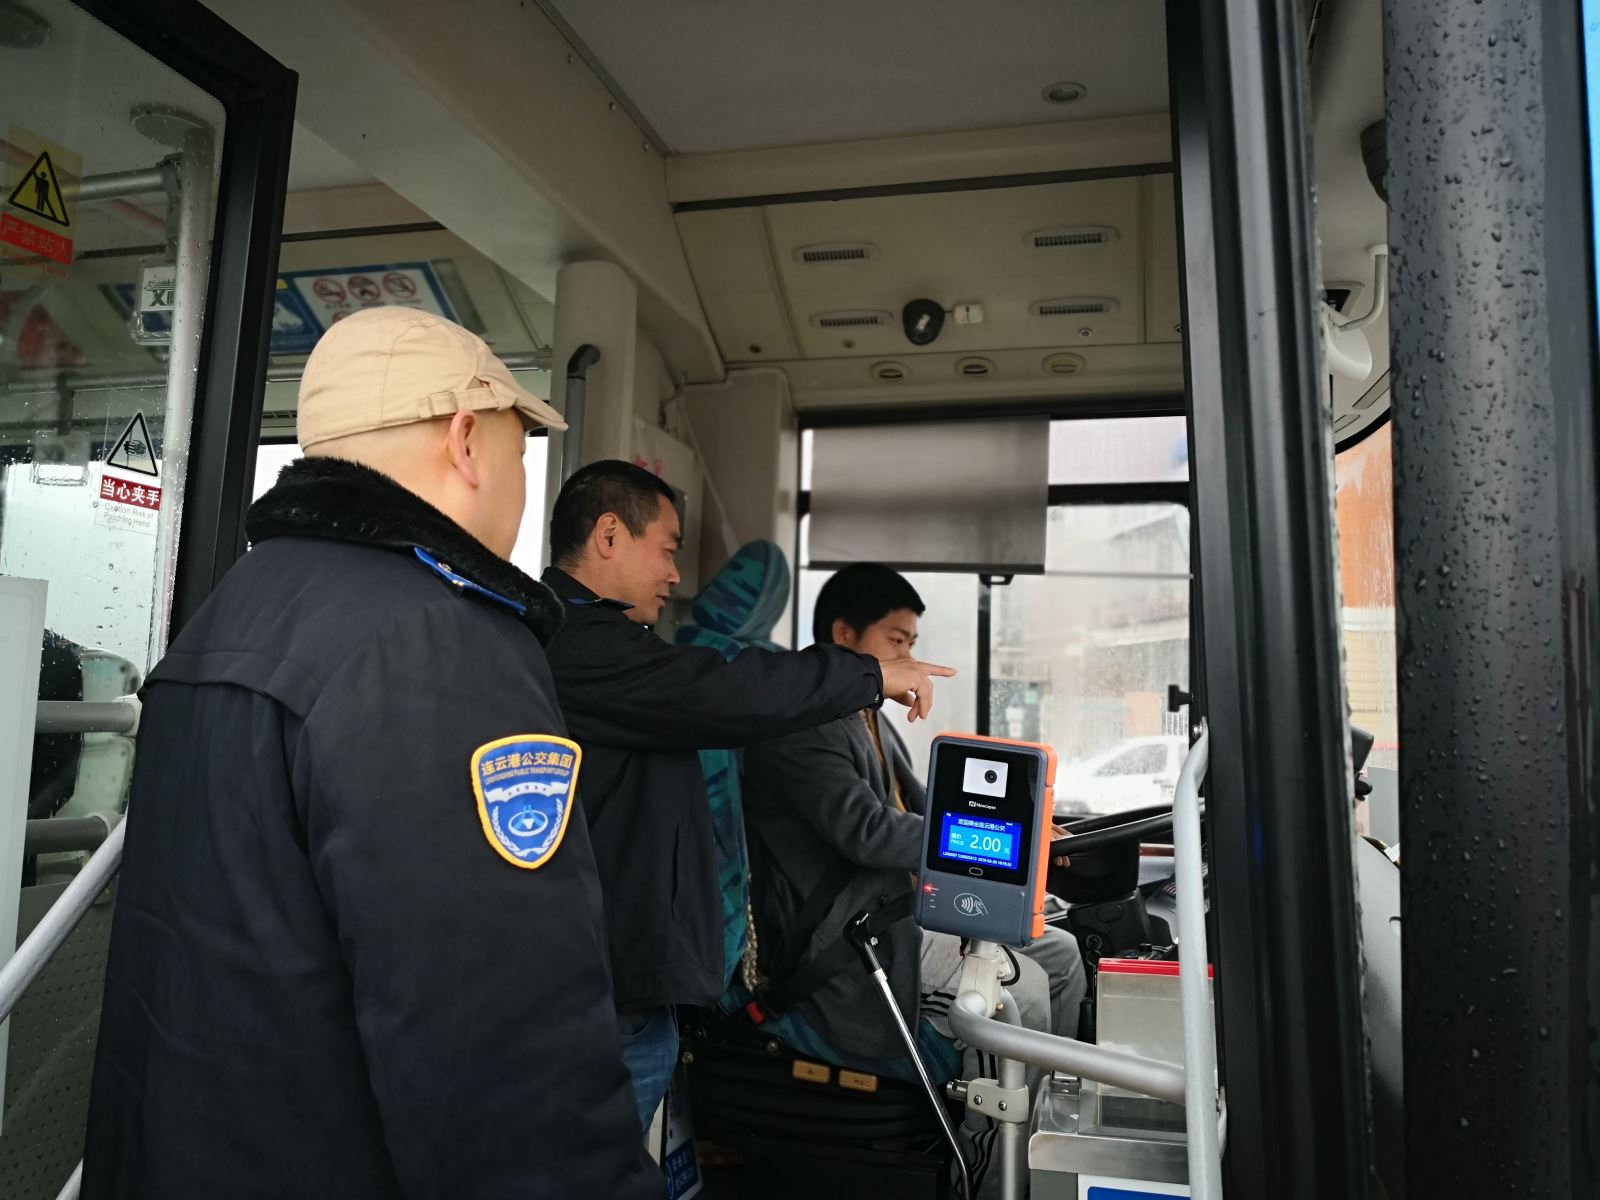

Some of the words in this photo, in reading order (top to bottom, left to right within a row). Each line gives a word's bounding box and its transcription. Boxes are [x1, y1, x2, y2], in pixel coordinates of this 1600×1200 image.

[2, 220, 67, 258] 严禁站人
[102, 479, 159, 506] 当心夹手
[104, 512, 131, 525] Pinching
[132, 508, 146, 517] Risk
[482, 752, 573, 776] 连云港公交集团
[970, 834, 1001, 852] 2.00
